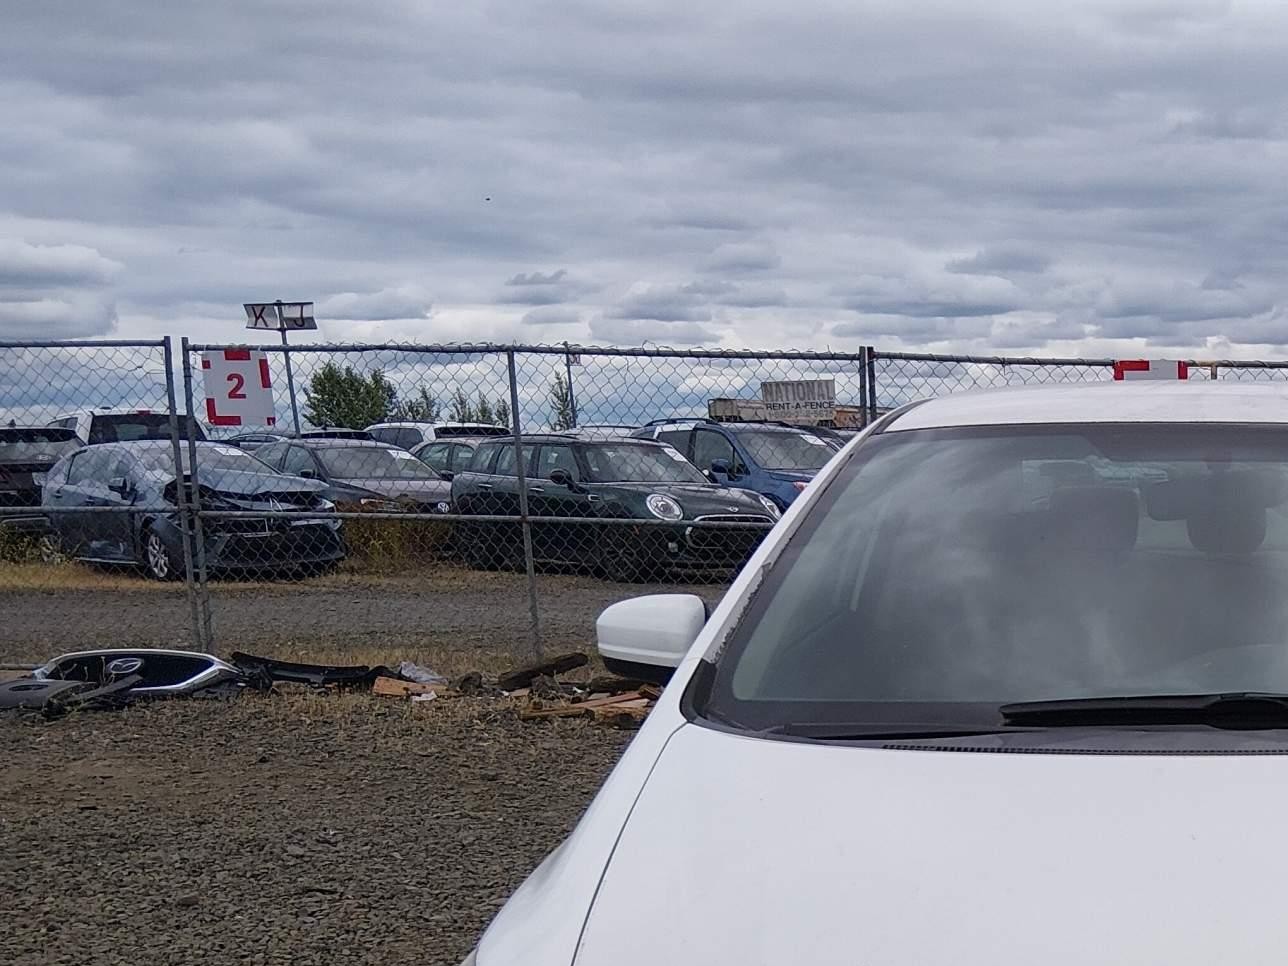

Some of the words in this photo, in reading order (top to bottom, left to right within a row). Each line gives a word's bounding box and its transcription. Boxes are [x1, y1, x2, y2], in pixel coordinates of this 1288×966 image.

[251, 305, 269, 328] K
[294, 304, 305, 328] J
[226, 373, 247, 399] 2
[763, 381, 834, 402] NATIONAL
[766, 401, 835, 411] RENT-A-FENCE
